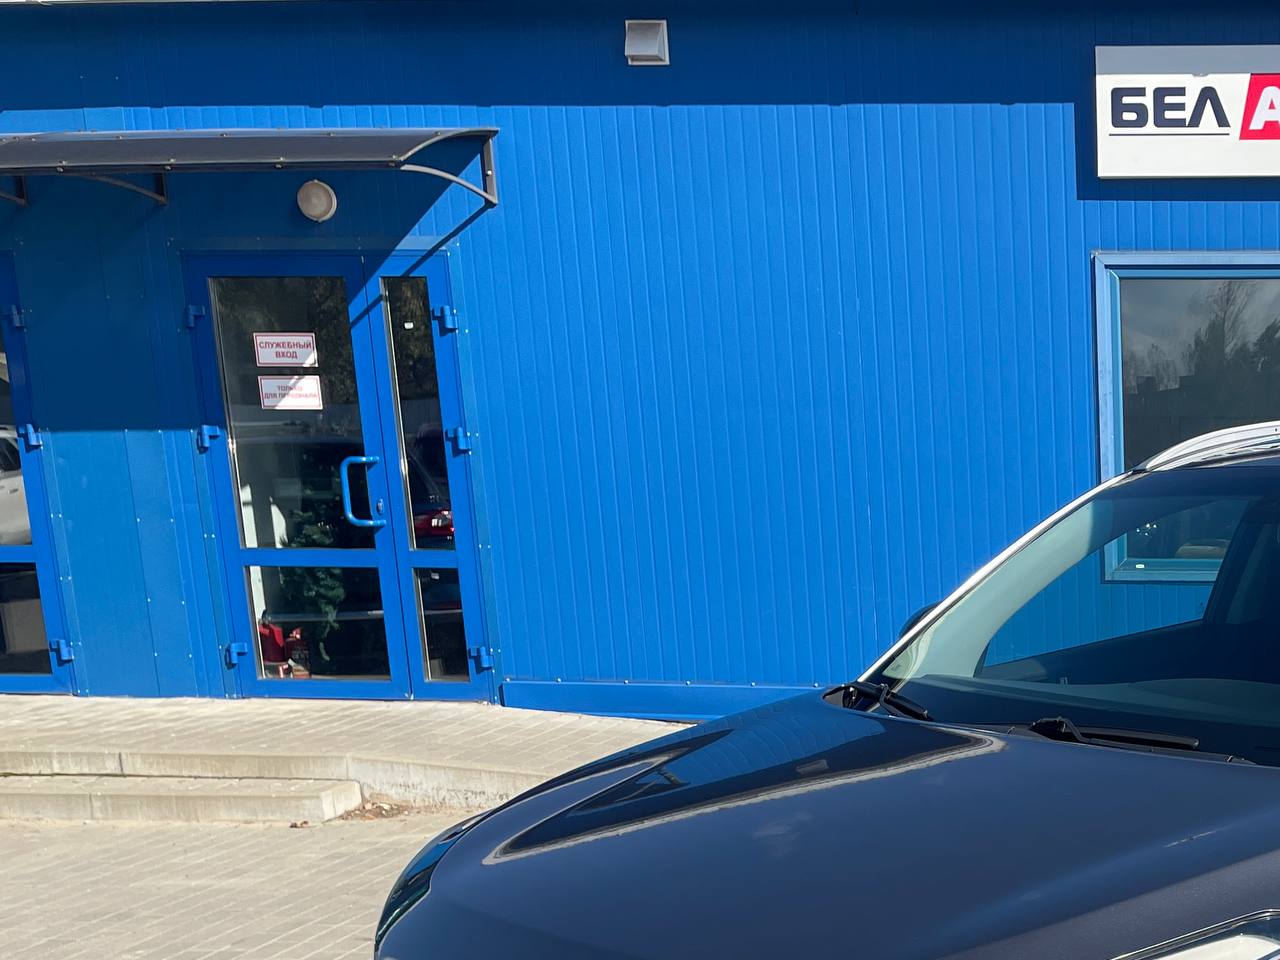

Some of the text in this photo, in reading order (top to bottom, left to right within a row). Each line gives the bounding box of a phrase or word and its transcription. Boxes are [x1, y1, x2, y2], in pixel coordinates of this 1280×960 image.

[1110, 86, 1230, 129] БЕЛ
[258, 340, 312, 349] СЛУЖЕБНЫЙ
[275, 351, 298, 359] ВХОД
